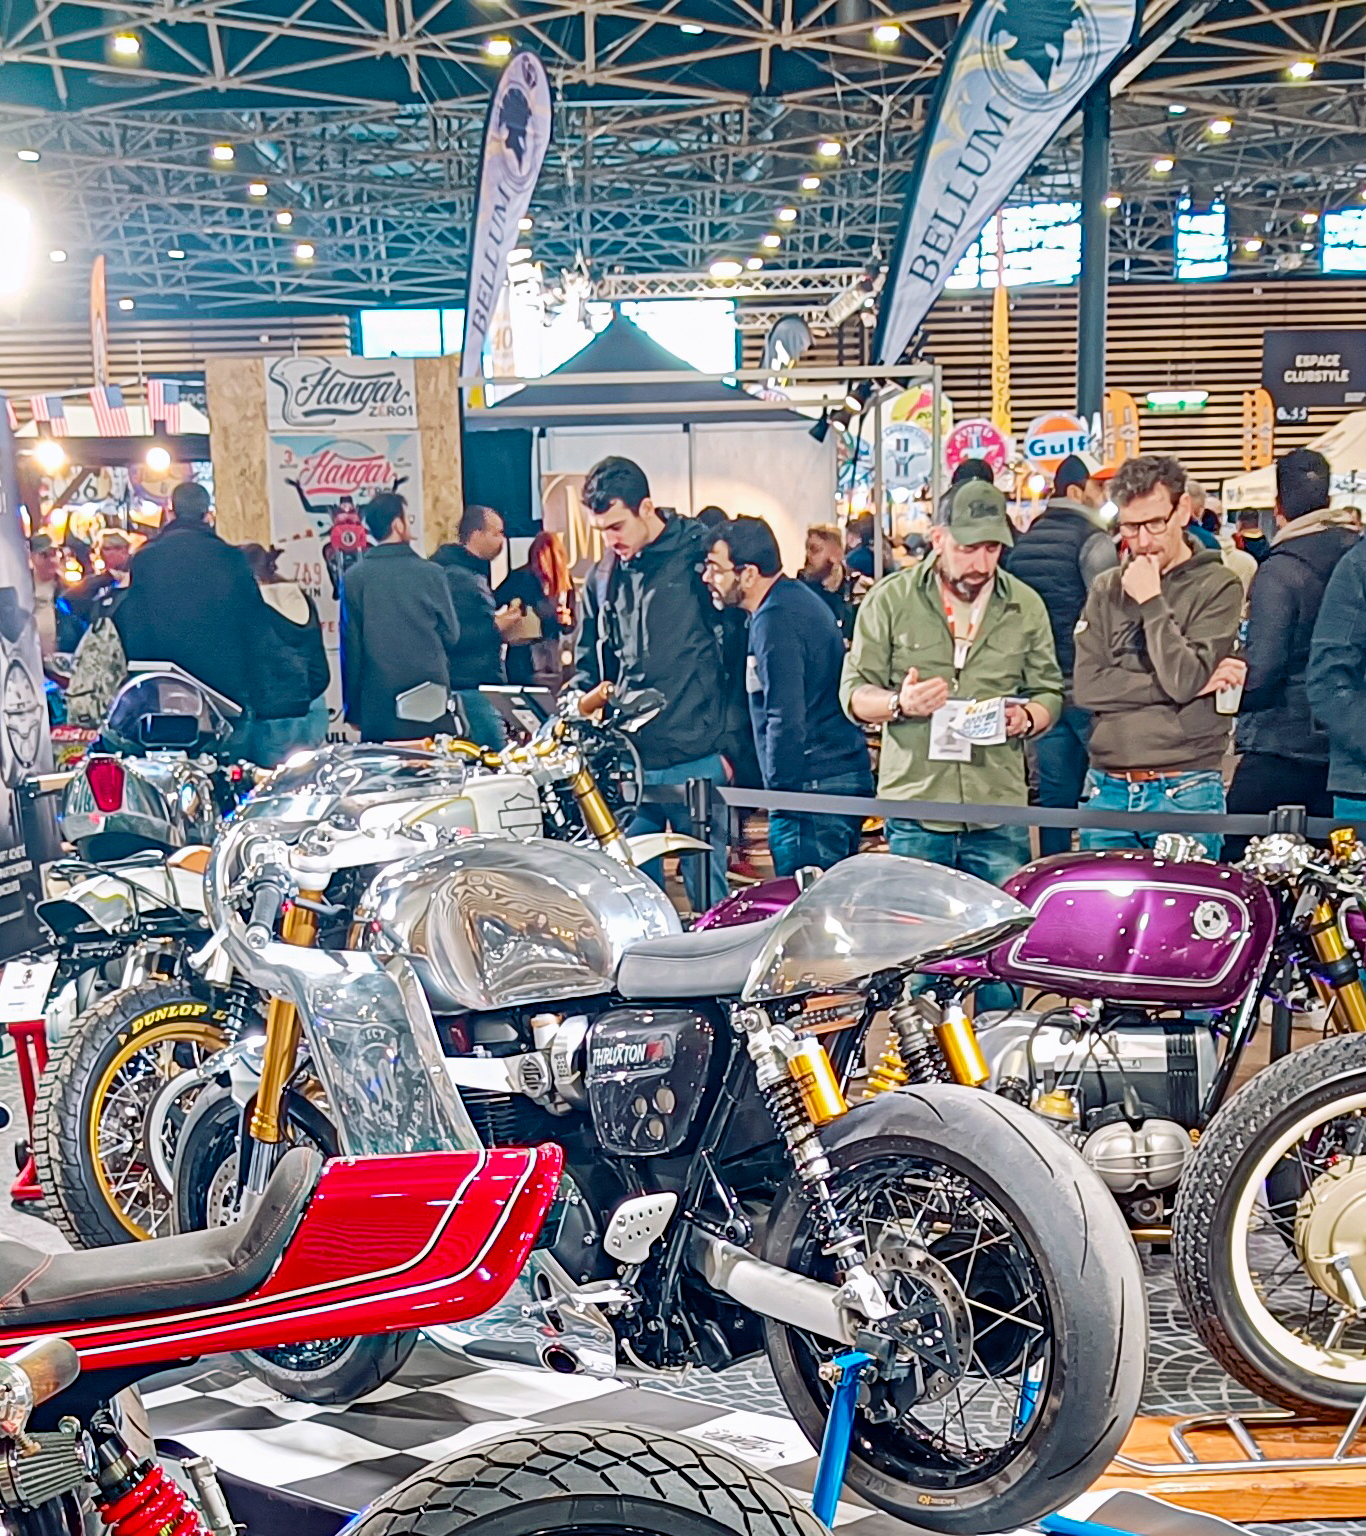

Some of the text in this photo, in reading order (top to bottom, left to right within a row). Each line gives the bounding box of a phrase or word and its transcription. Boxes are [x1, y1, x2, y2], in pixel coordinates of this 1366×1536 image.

[909, 102, 1015, 287] BELLUM
[471, 184, 512, 339] BELLUM
[1295, 354, 1342, 368] ESPACE
[296, 364, 411, 412] Hangar
[1283, 369, 1350, 383] CLUBSTYLE
[1028, 436, 1093, 458] Gulf
[299, 450, 397, 494] Hangar
[50, 726, 98, 742] Castro
[325, 731, 349, 744] ULL
[131, 1003, 209, 1036] DUNLOP
[592, 1043, 647, 1067] THRUXTON
